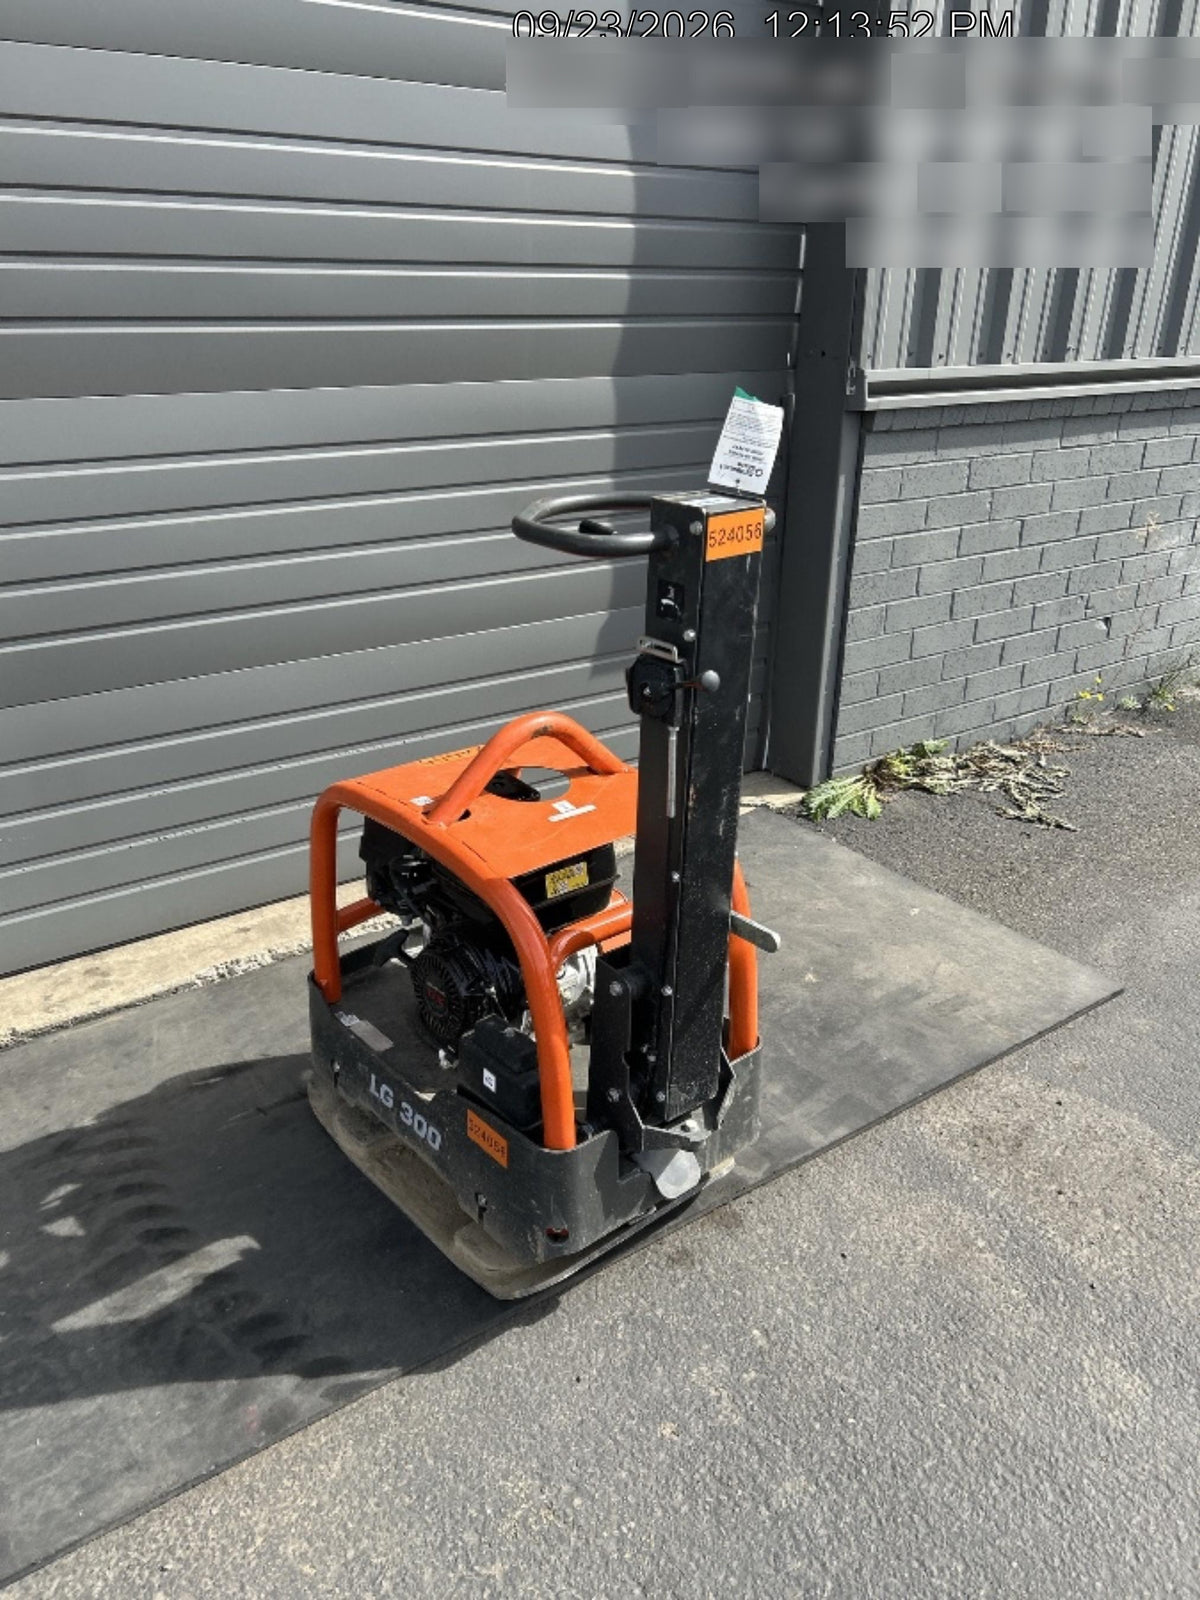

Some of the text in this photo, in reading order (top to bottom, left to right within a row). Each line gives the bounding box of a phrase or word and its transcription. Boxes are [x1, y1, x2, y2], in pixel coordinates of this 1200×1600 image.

[708, 522, 763, 548] 524056
[369, 1073, 442, 1151] LG 300
